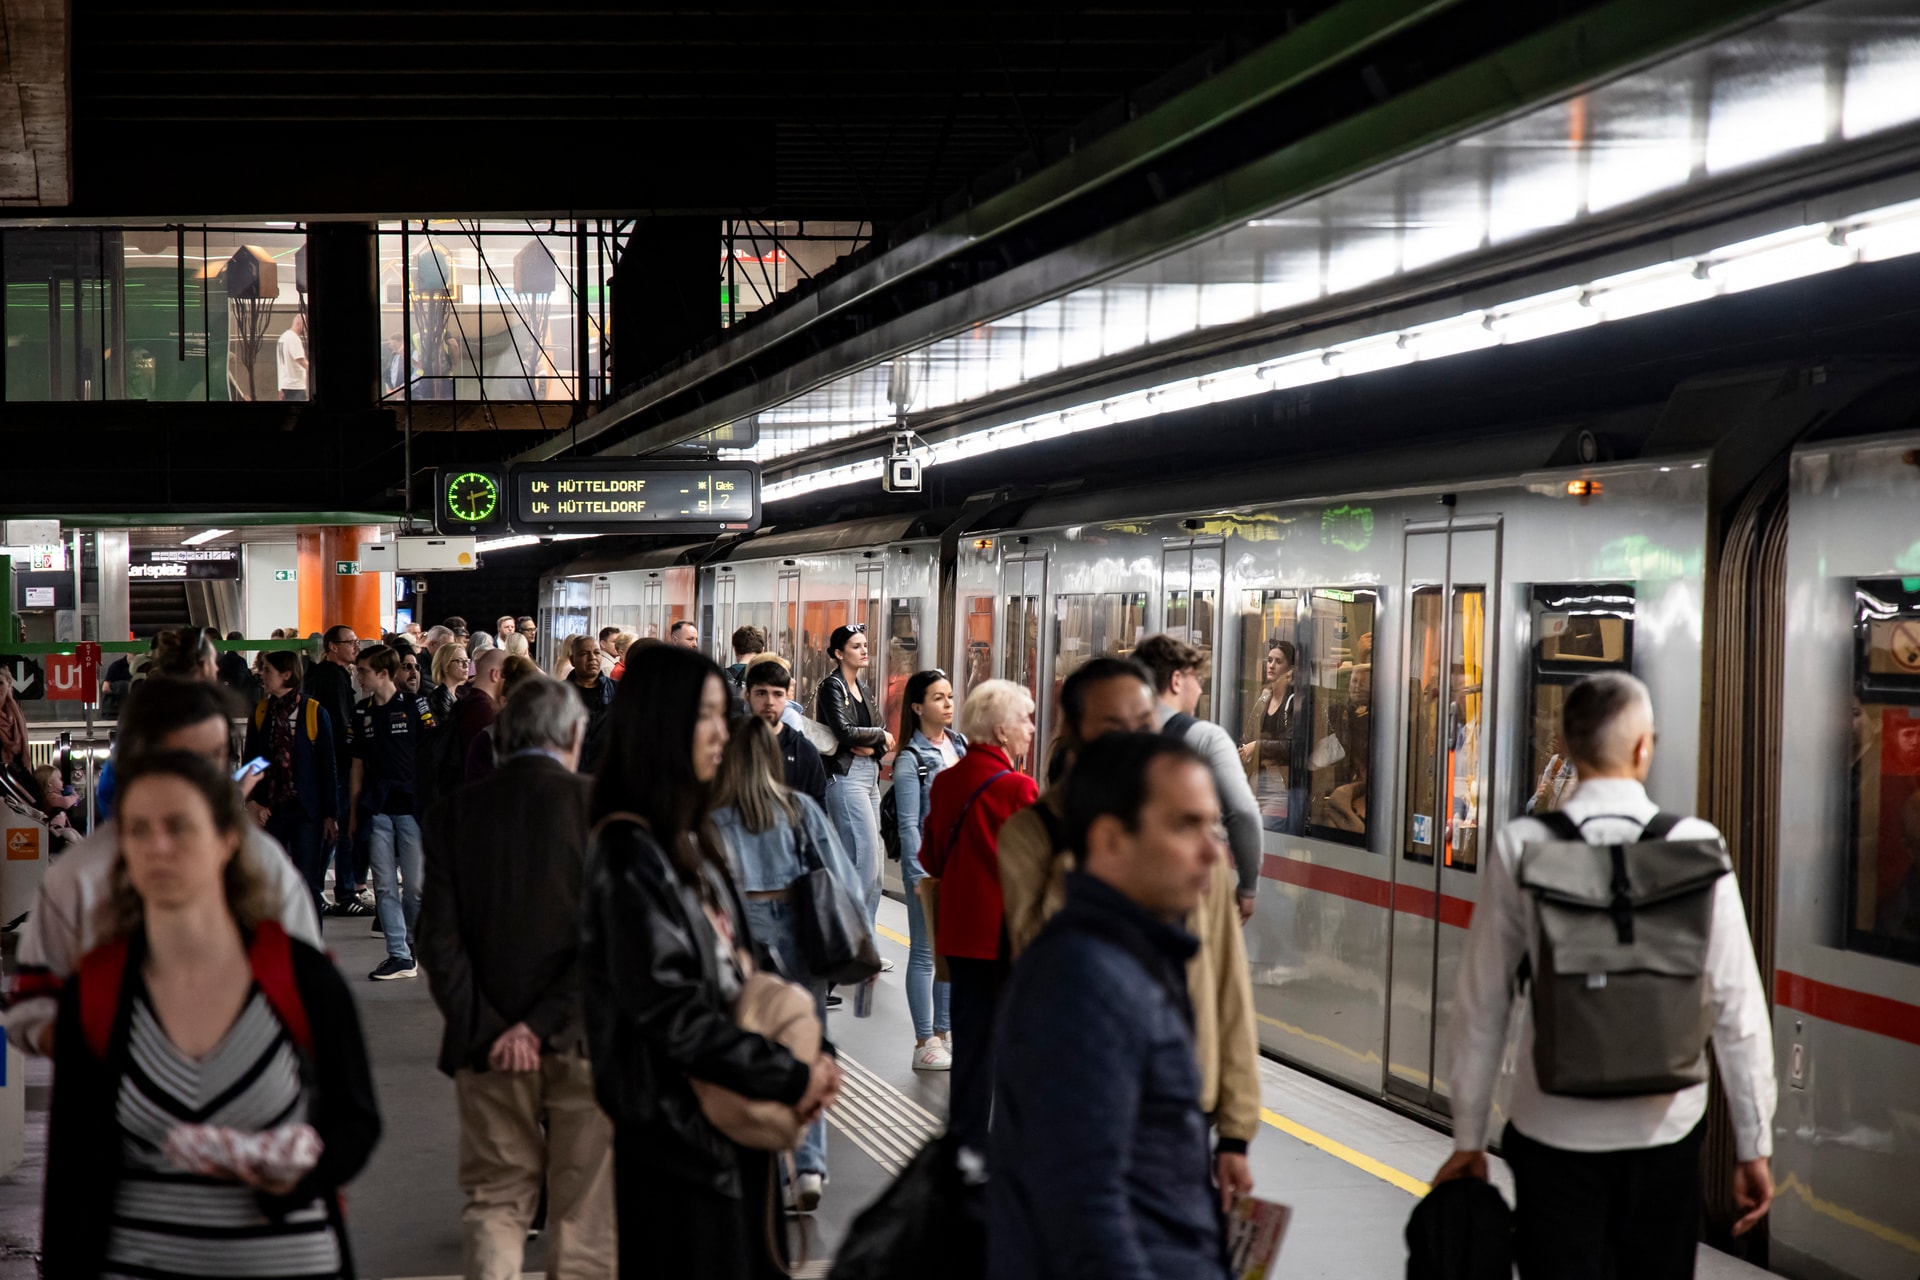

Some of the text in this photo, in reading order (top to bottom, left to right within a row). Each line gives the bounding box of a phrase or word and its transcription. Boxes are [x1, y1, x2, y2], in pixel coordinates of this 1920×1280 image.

[531, 480, 646, 493] U4 HÜTTELDORF
[715, 481, 734, 491] Gleis
[531, 500, 707, 513] U4 HÜTTELDORF 5
[720, 495, 729, 509] 2
